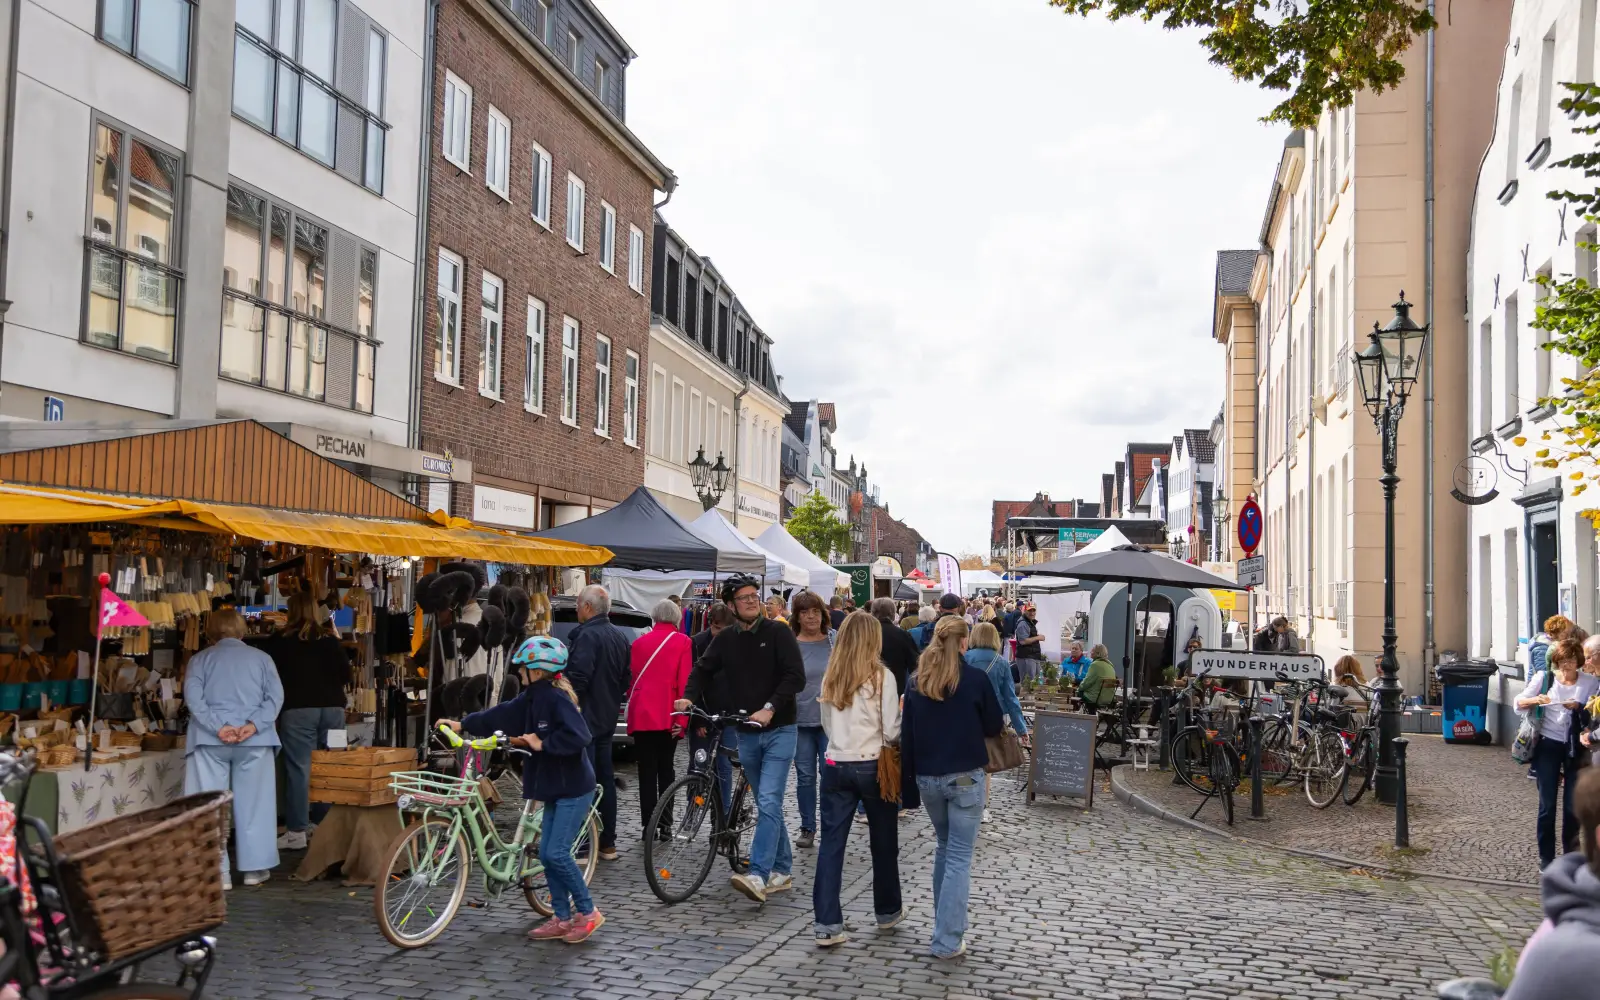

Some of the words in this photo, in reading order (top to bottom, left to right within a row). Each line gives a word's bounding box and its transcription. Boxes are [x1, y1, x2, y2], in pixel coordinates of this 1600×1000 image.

[317, 434, 366, 459] PECHAN
[423, 457, 451, 474] EURONICS
[1203, 658, 1310, 673] WUNDERHAUS
